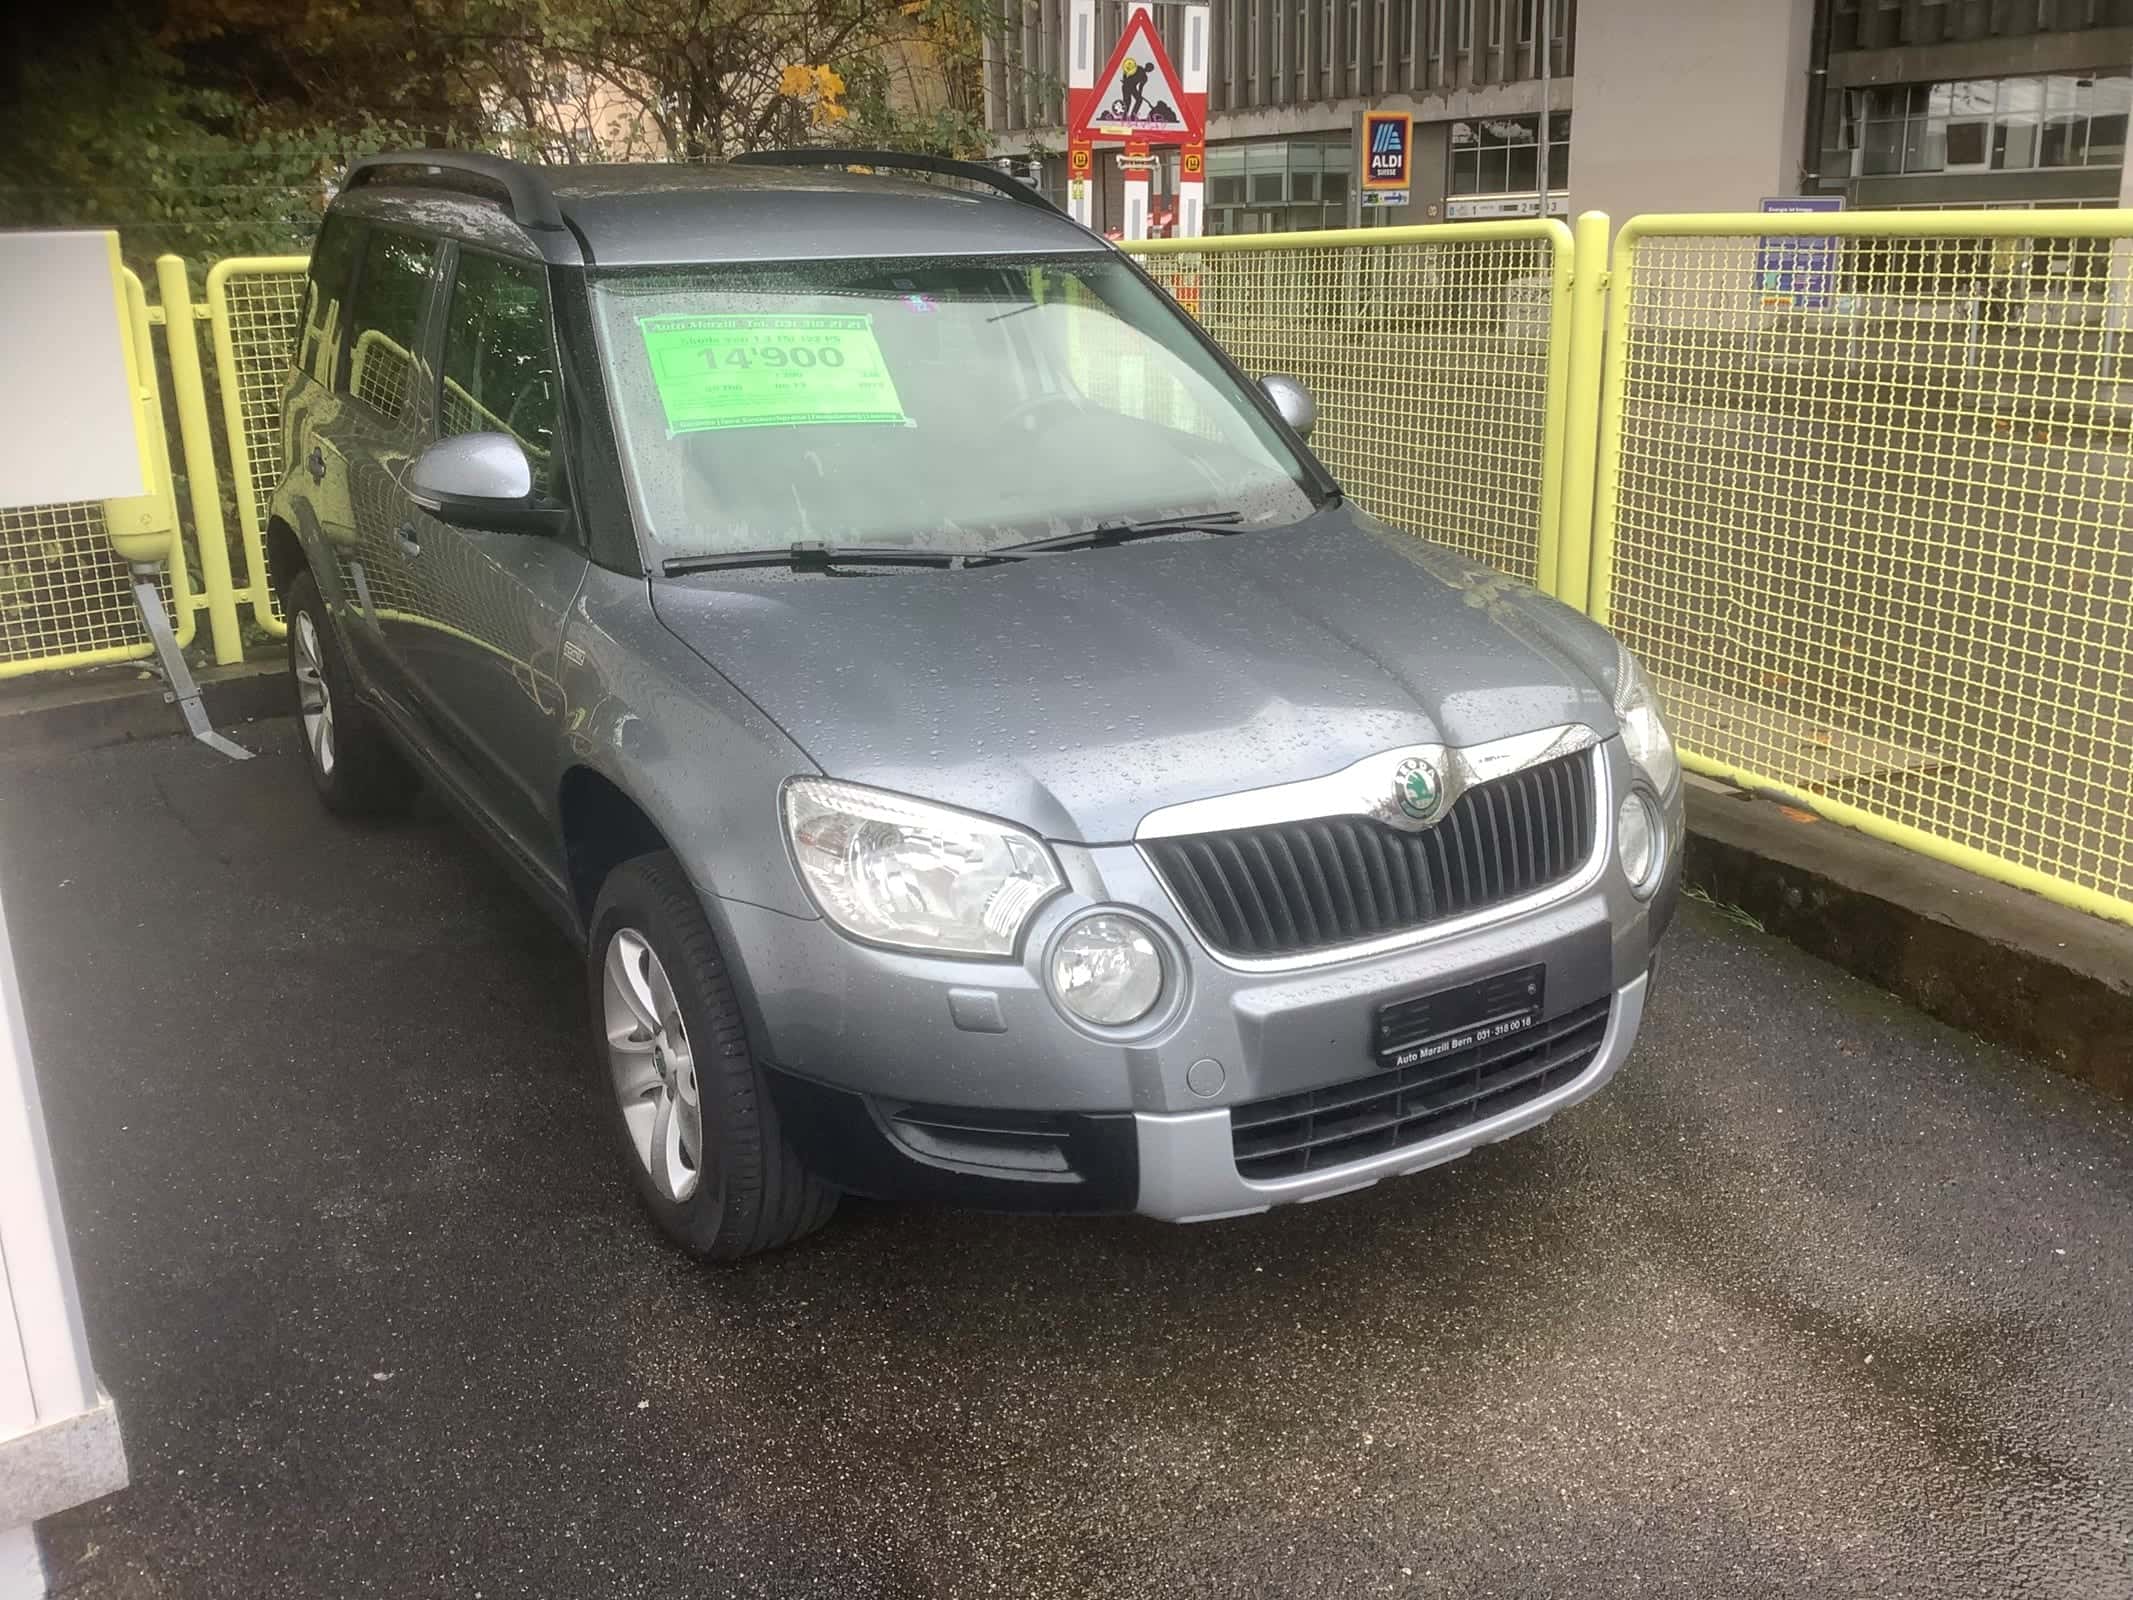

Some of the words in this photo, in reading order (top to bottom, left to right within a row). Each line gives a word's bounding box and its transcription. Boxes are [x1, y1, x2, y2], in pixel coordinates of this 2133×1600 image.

[1372, 154, 1402, 168] ALDI
[697, 346, 845, 369] 14'900
[1396, 1053, 1418, 1066] Auto
[1452, 1036, 1473, 1049] Bern
